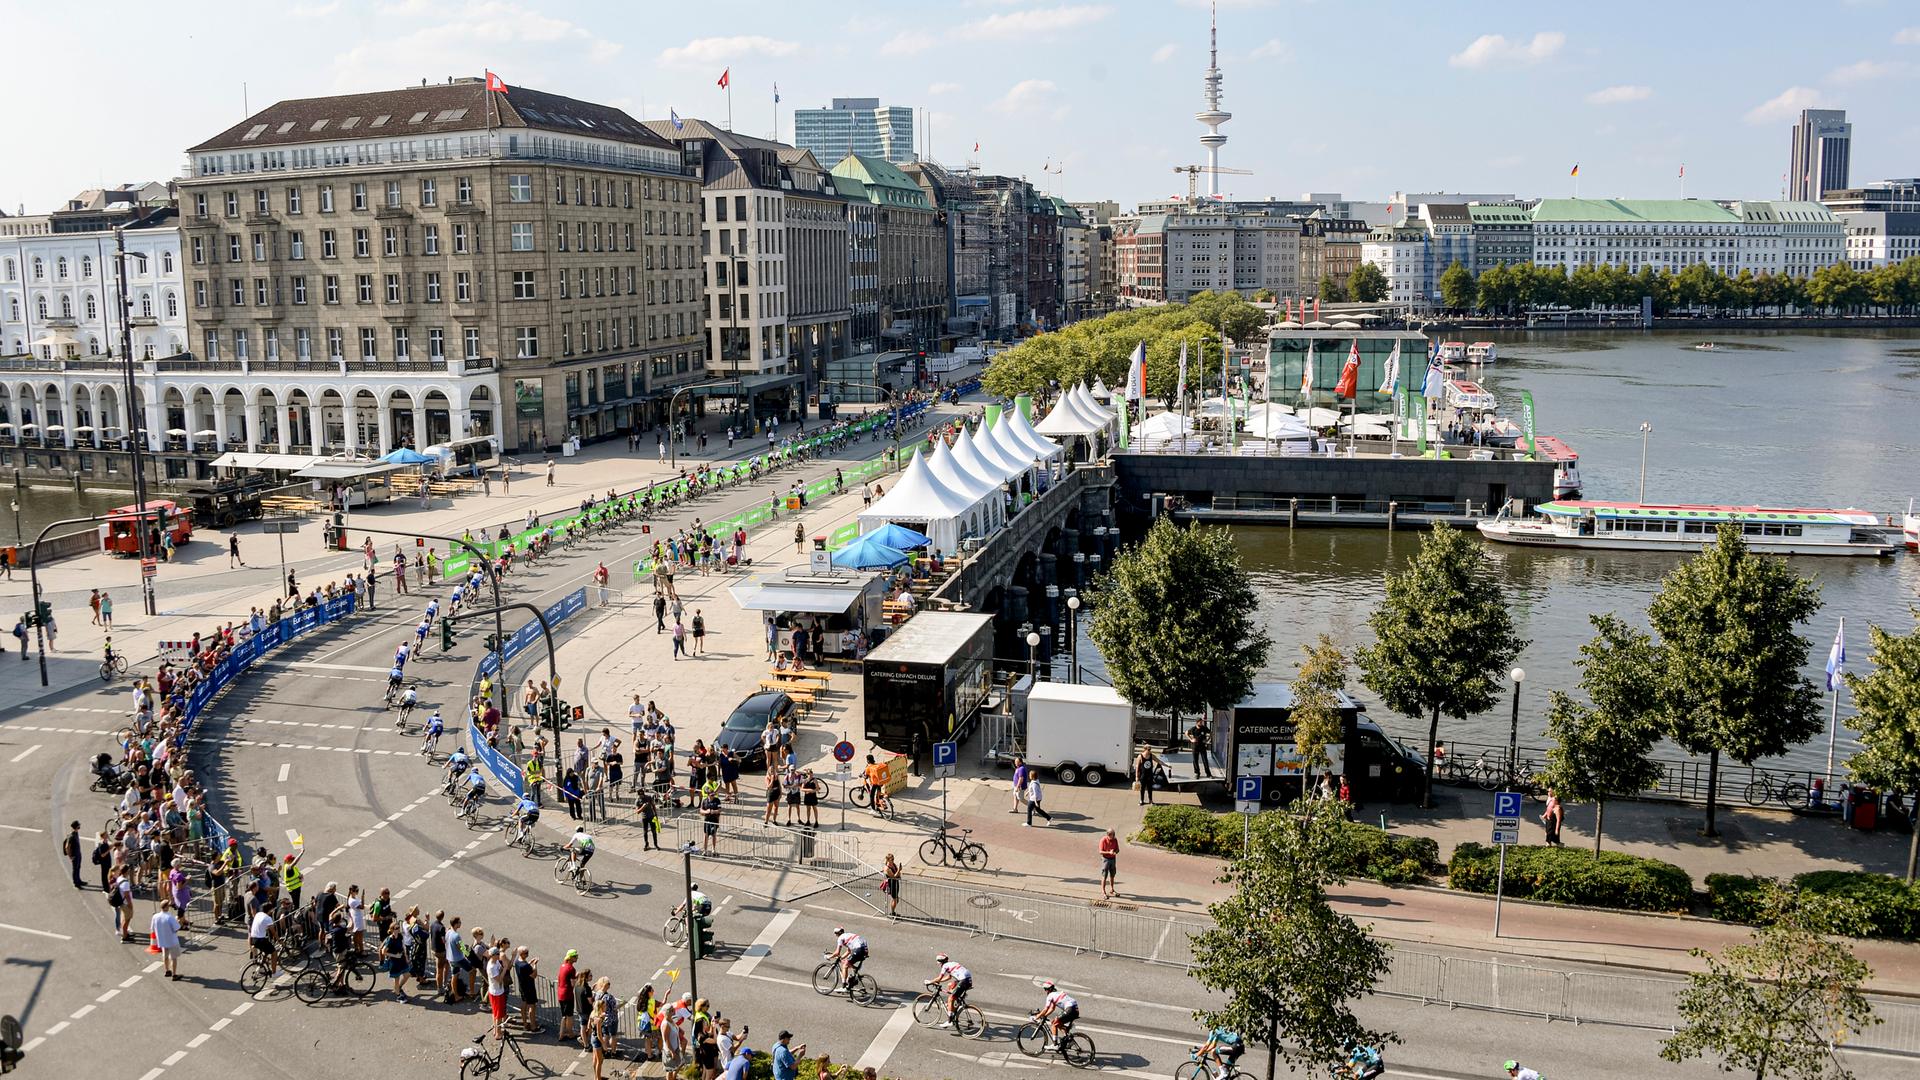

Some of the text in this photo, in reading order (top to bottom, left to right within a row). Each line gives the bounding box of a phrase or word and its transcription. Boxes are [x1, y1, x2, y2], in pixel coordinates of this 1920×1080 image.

[896, 275, 933, 285] ALSTRHAUS
[870, 671, 895, 679] CATERING
[1239, 726, 1279, 734] CATERING
[939, 746, 951, 762] P
[1242, 780, 1256, 798] P
[1498, 795, 1514, 814] P
